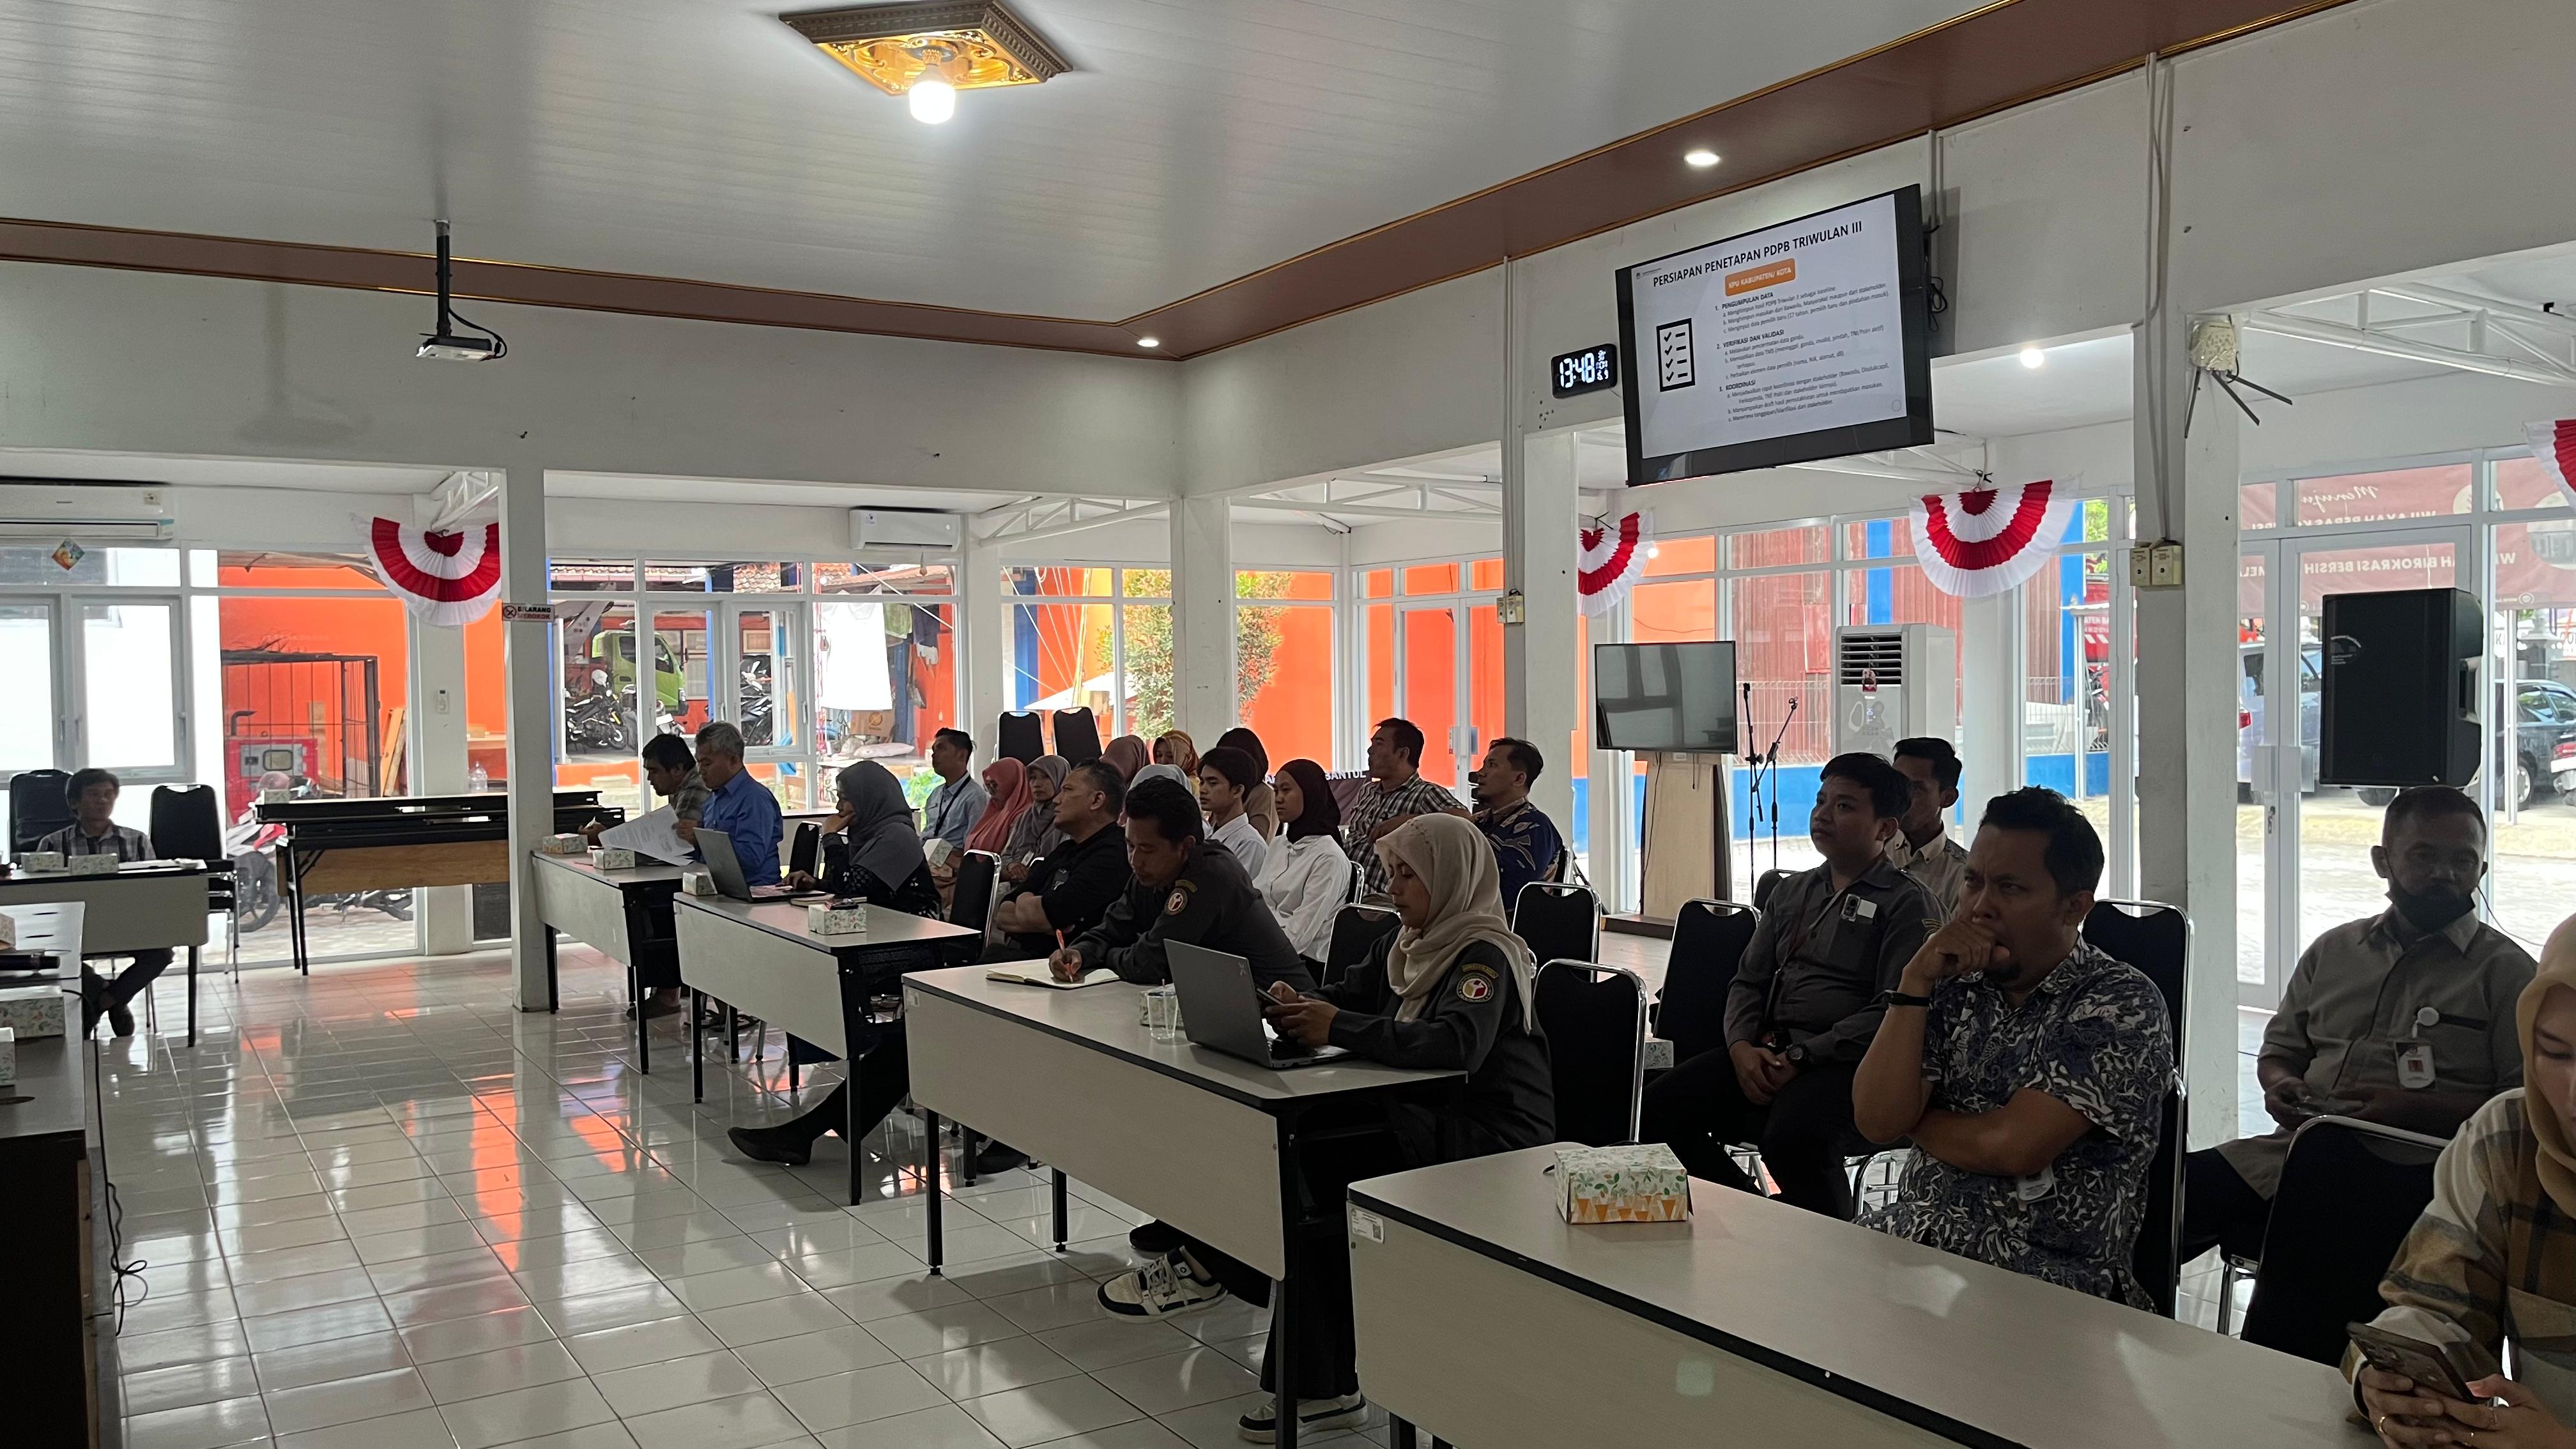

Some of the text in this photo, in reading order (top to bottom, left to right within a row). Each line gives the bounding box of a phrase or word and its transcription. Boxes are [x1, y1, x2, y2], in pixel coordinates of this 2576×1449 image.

[1653, 264, 1702, 288] PERSIAPAN
[1705, 249, 1760, 273] PENETAPAN
[1763, 240, 1790, 257] PDPB
[1793, 224, 1848, 250] TRIWULAN
[1851, 220, 1862, 234] III
[1728, 266, 1791, 289] KPU KABUPATEN/ KOTA
[1722, 295, 1759, 309] PENGUMPULAN
[1722, 337, 1748, 348] VERIFIKASI
[1761, 329, 1784, 339] VALIDASI
[1560, 352, 1596, 388] 13:48
[1726, 379, 1755, 390] KOORDINASI
